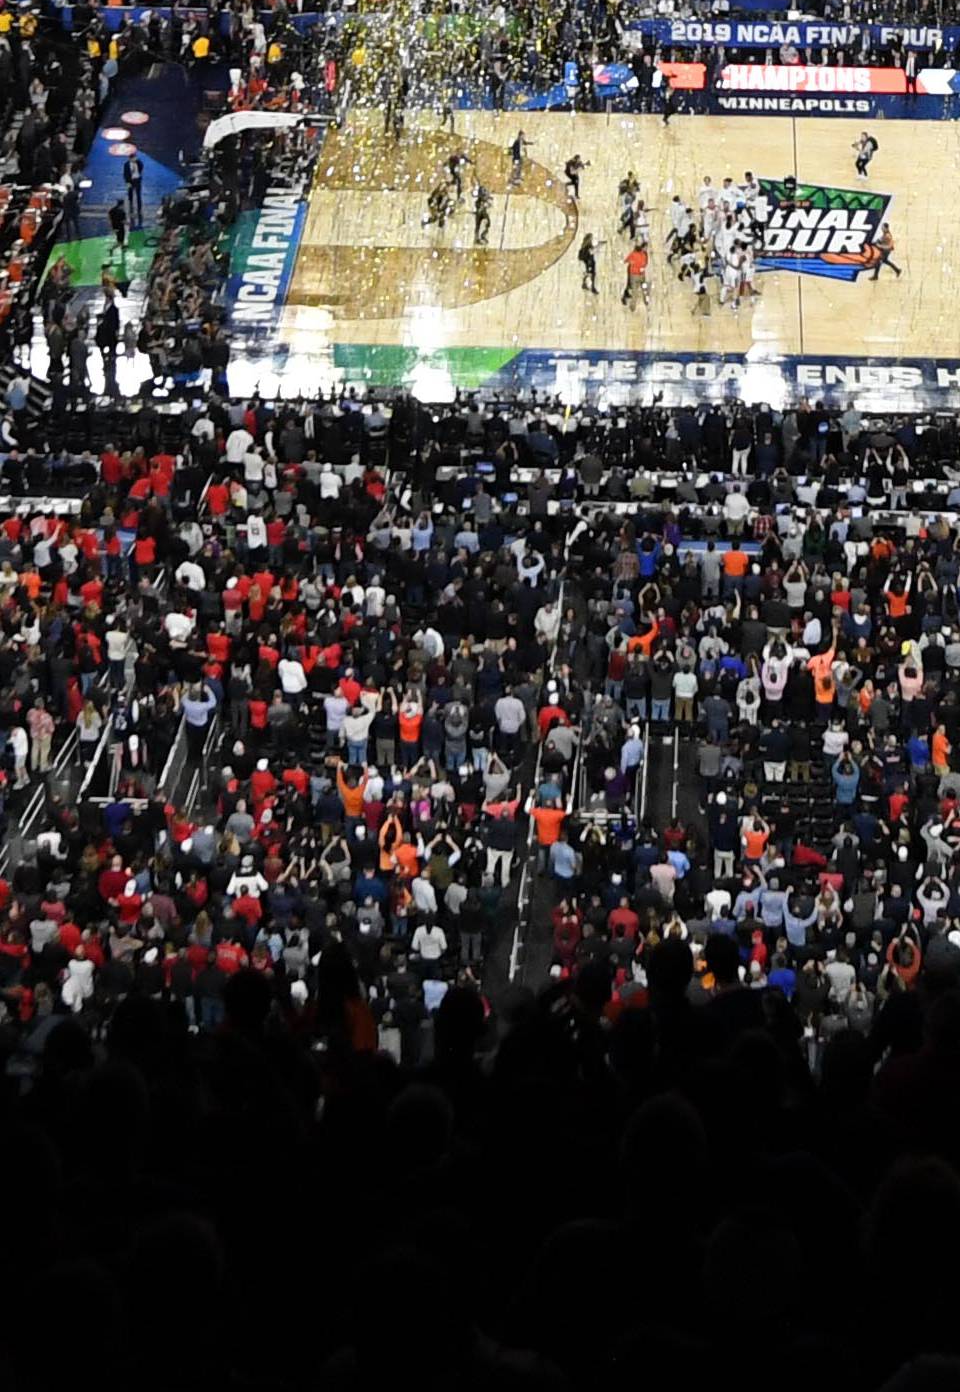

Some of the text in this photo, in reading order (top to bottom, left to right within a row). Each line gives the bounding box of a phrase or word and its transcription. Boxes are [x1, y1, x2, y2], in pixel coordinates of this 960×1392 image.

[671, 23, 731, 42] 2019
[737, 24, 801, 44] NCAA
[718, 96, 870, 113] MINNEAPOLIS
[769, 208, 873, 230] INAL
[763, 229, 867, 253] OUR
[231, 253, 287, 320] NCAA
[551, 359, 638, 382] THE
[653, 361, 782, 383] ROA
[797, 364, 923, 388] ENDS
